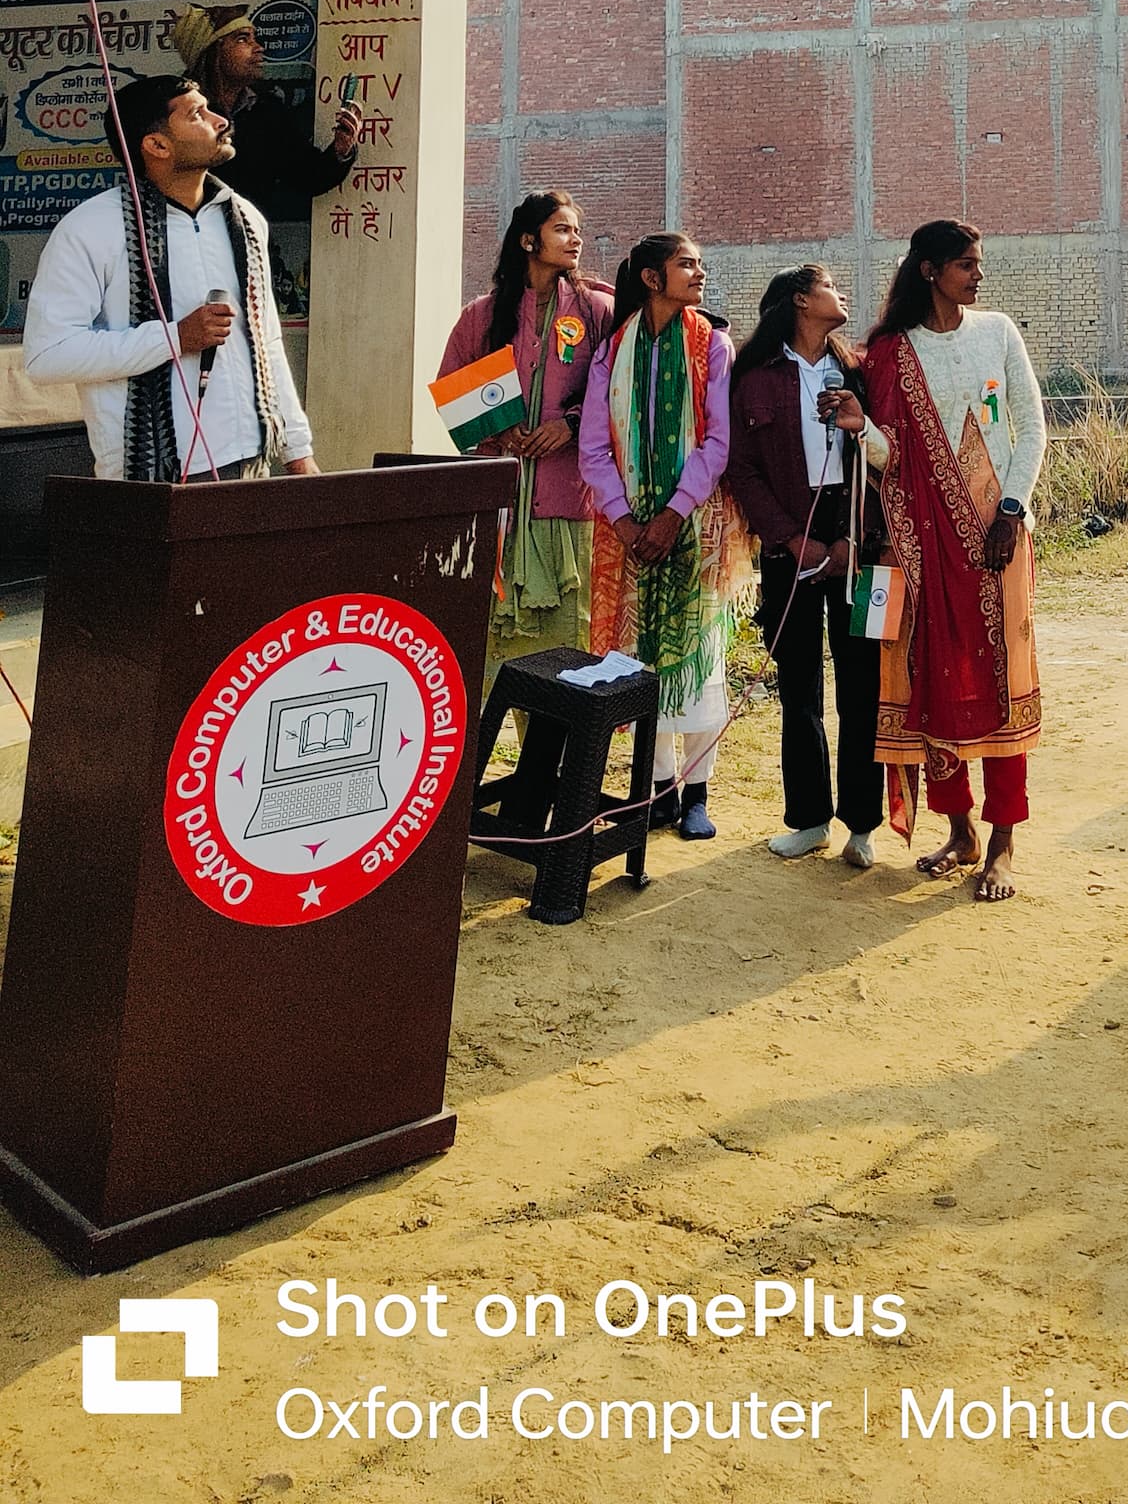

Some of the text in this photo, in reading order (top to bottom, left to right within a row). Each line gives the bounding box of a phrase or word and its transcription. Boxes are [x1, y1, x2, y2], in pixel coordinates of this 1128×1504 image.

[338, 34, 388, 61] आप
[39, 108, 88, 129] CCC
[23, 152, 90, 167] Available
[352, 165, 407, 193] नजर
[2, 196, 84, 212] (TallyPrim
[329, 204, 354, 239] में
[361, 201, 380, 242] हैं
[175, 604, 458, 906] Oxford Computer & Educational Institute
